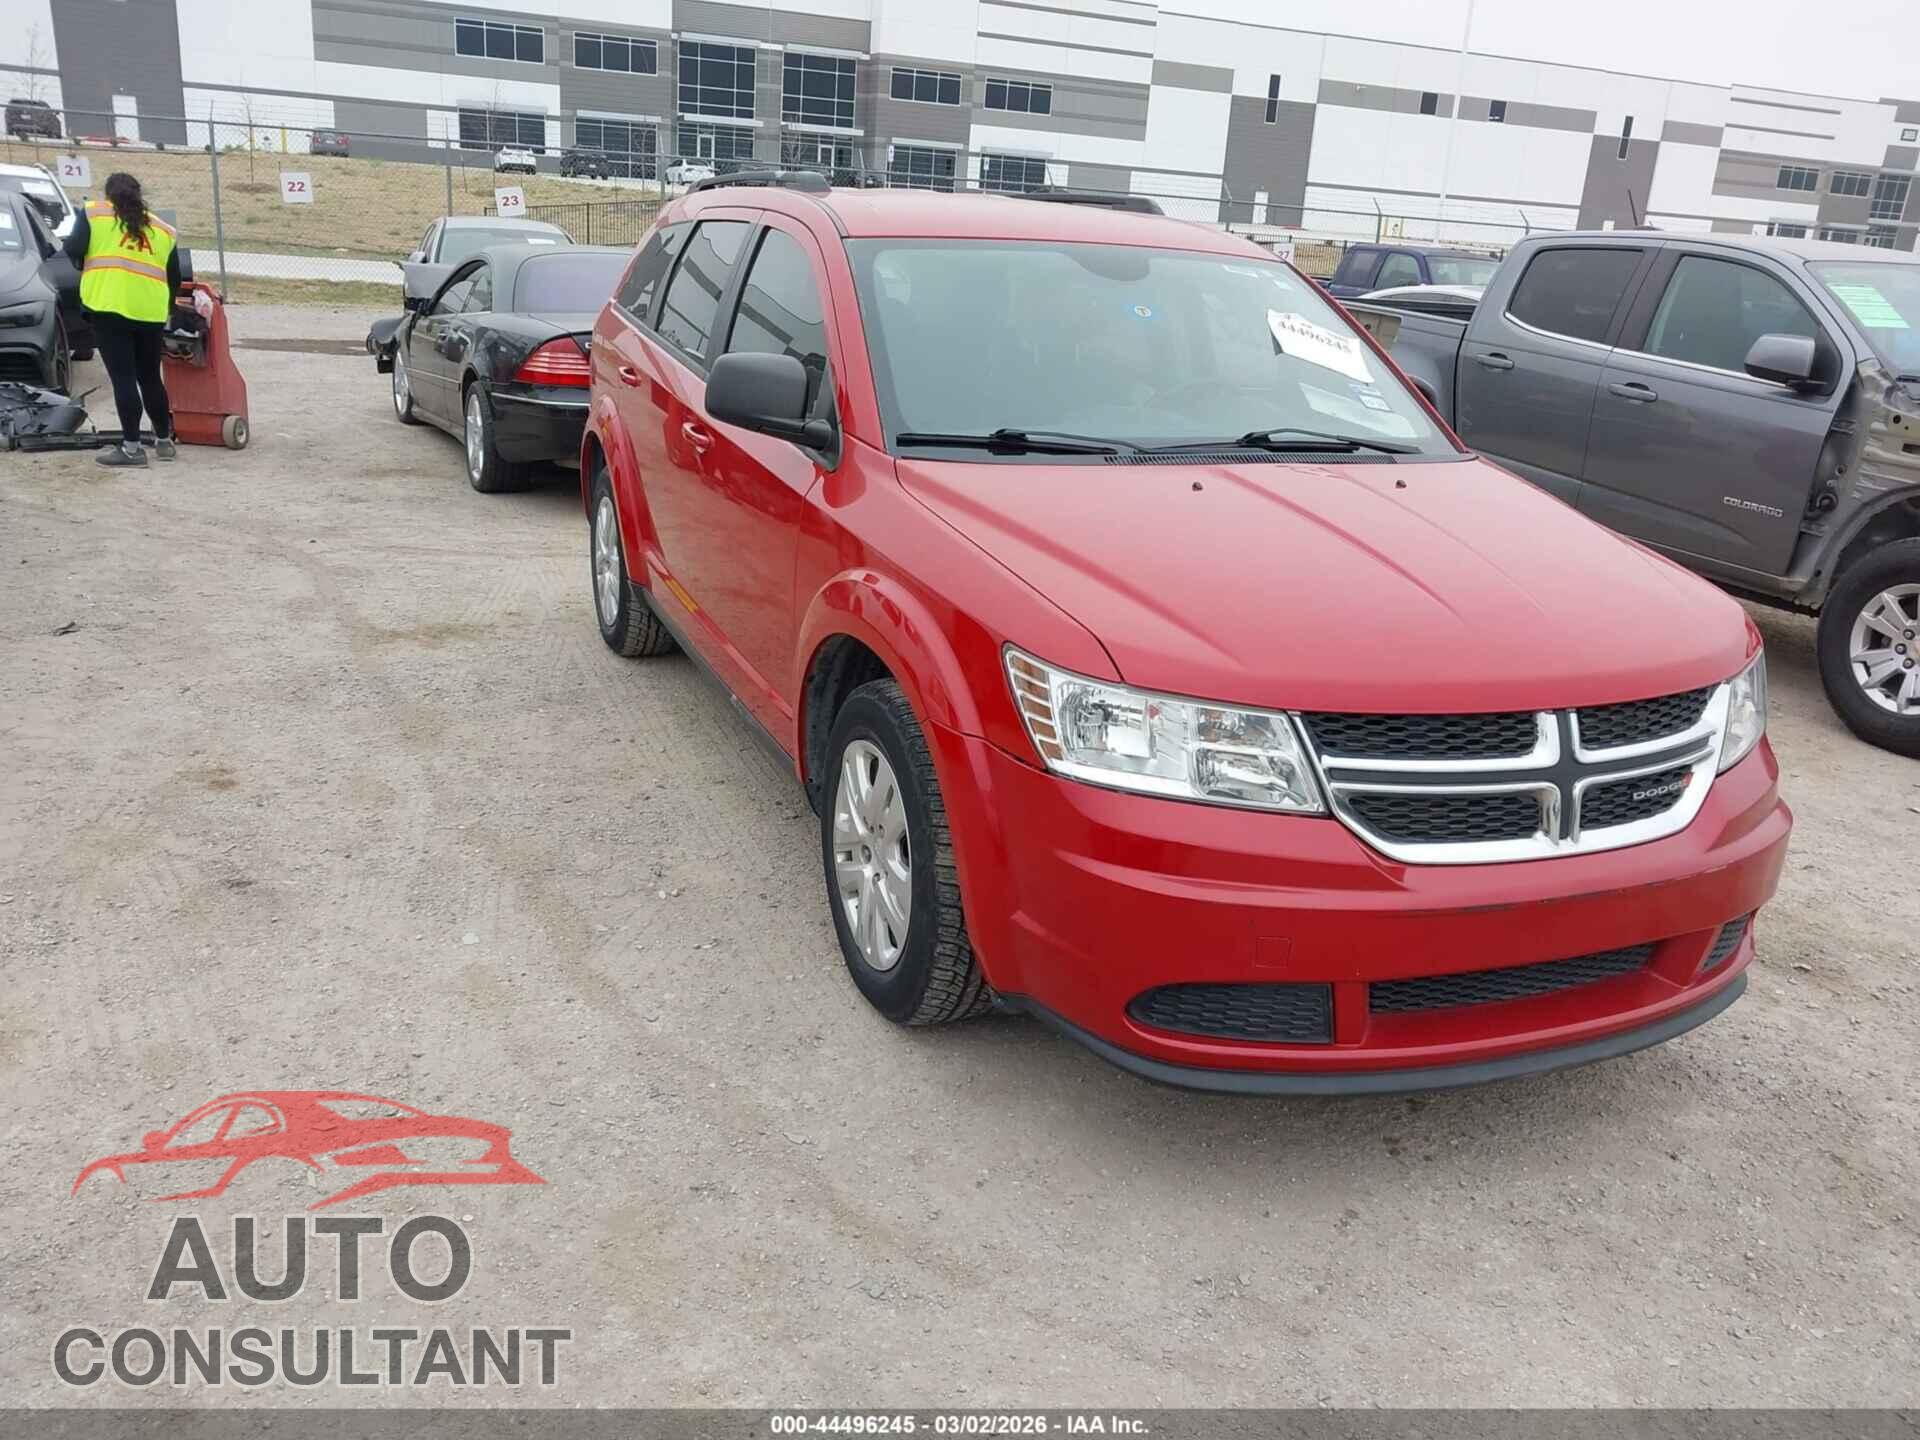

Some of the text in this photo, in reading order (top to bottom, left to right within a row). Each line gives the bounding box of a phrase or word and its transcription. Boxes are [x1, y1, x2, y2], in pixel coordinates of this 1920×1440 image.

[64, 164, 82, 176] 21
[287, 181, 305, 192] 22
[502, 195, 519, 206] 23
[1723, 496, 1783, 518] COLORADO
